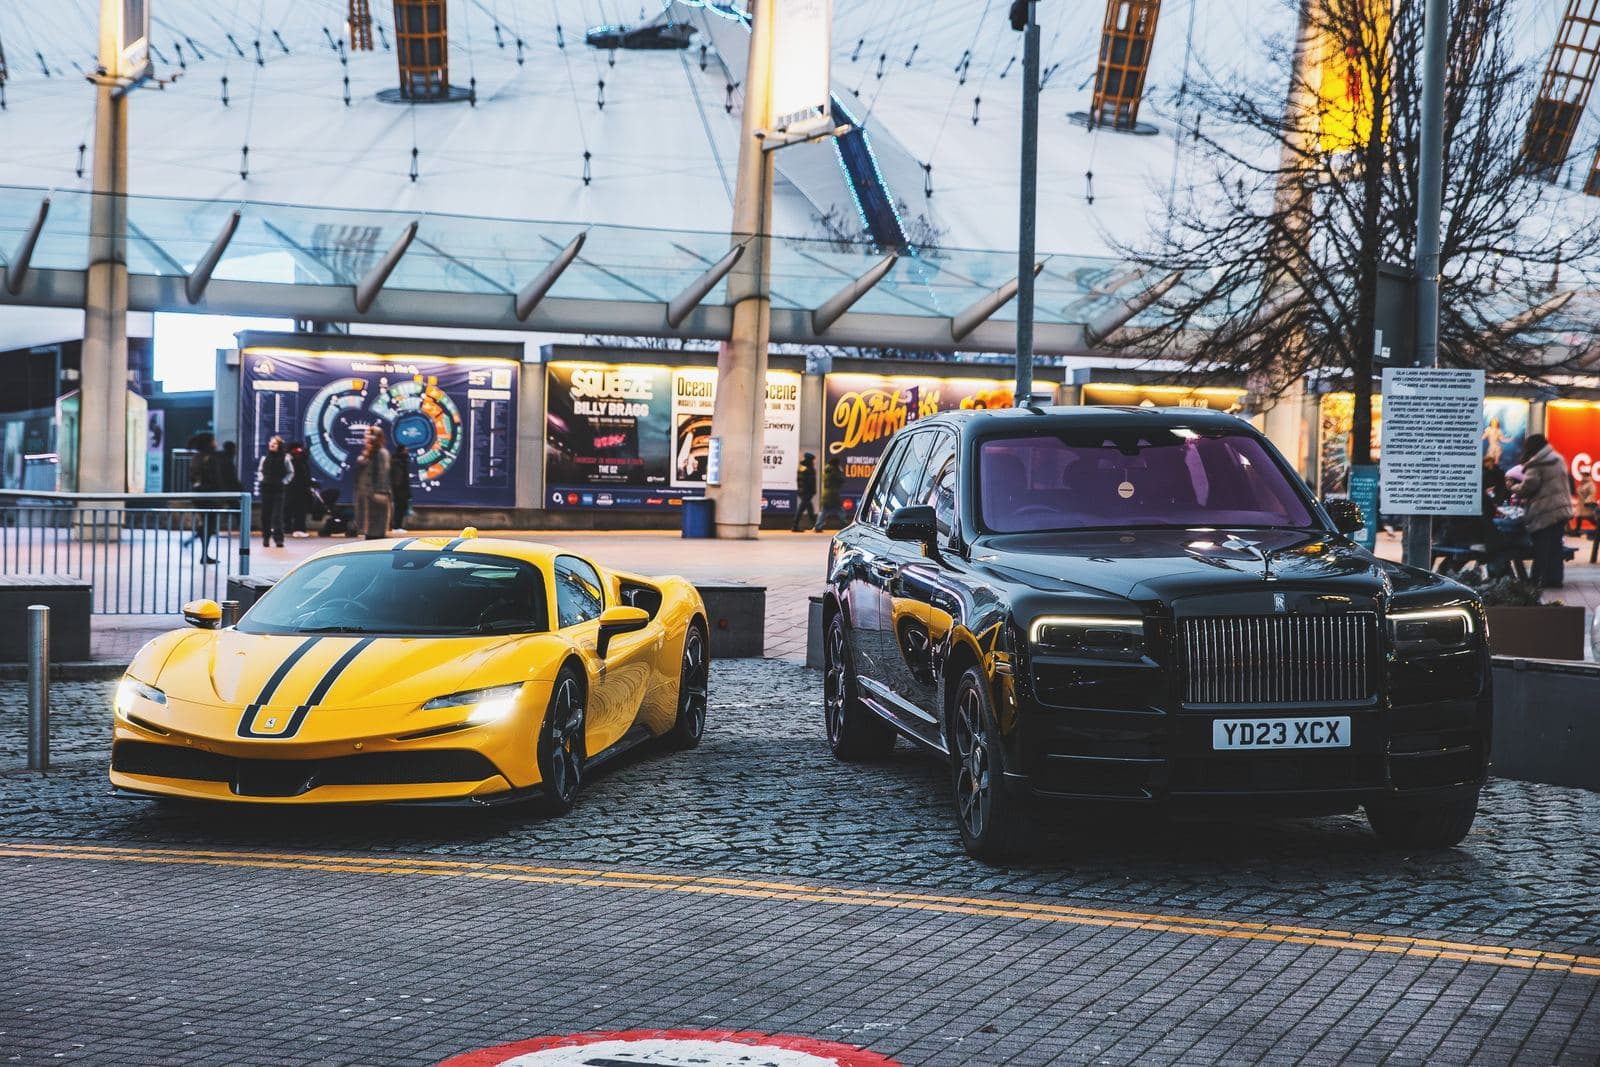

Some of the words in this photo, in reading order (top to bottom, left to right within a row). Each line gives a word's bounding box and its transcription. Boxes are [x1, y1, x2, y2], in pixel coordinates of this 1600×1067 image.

[570, 369, 653, 400] SQUEEZE
[678, 377, 712, 397] Ocean
[574, 401, 607, 415] BILLY
[608, 402, 650, 416] BRAGG
[846, 456, 874, 464] WEDNESDAY
[1223, 722, 1288, 745] YD23
[1294, 720, 1340, 744] XCX
